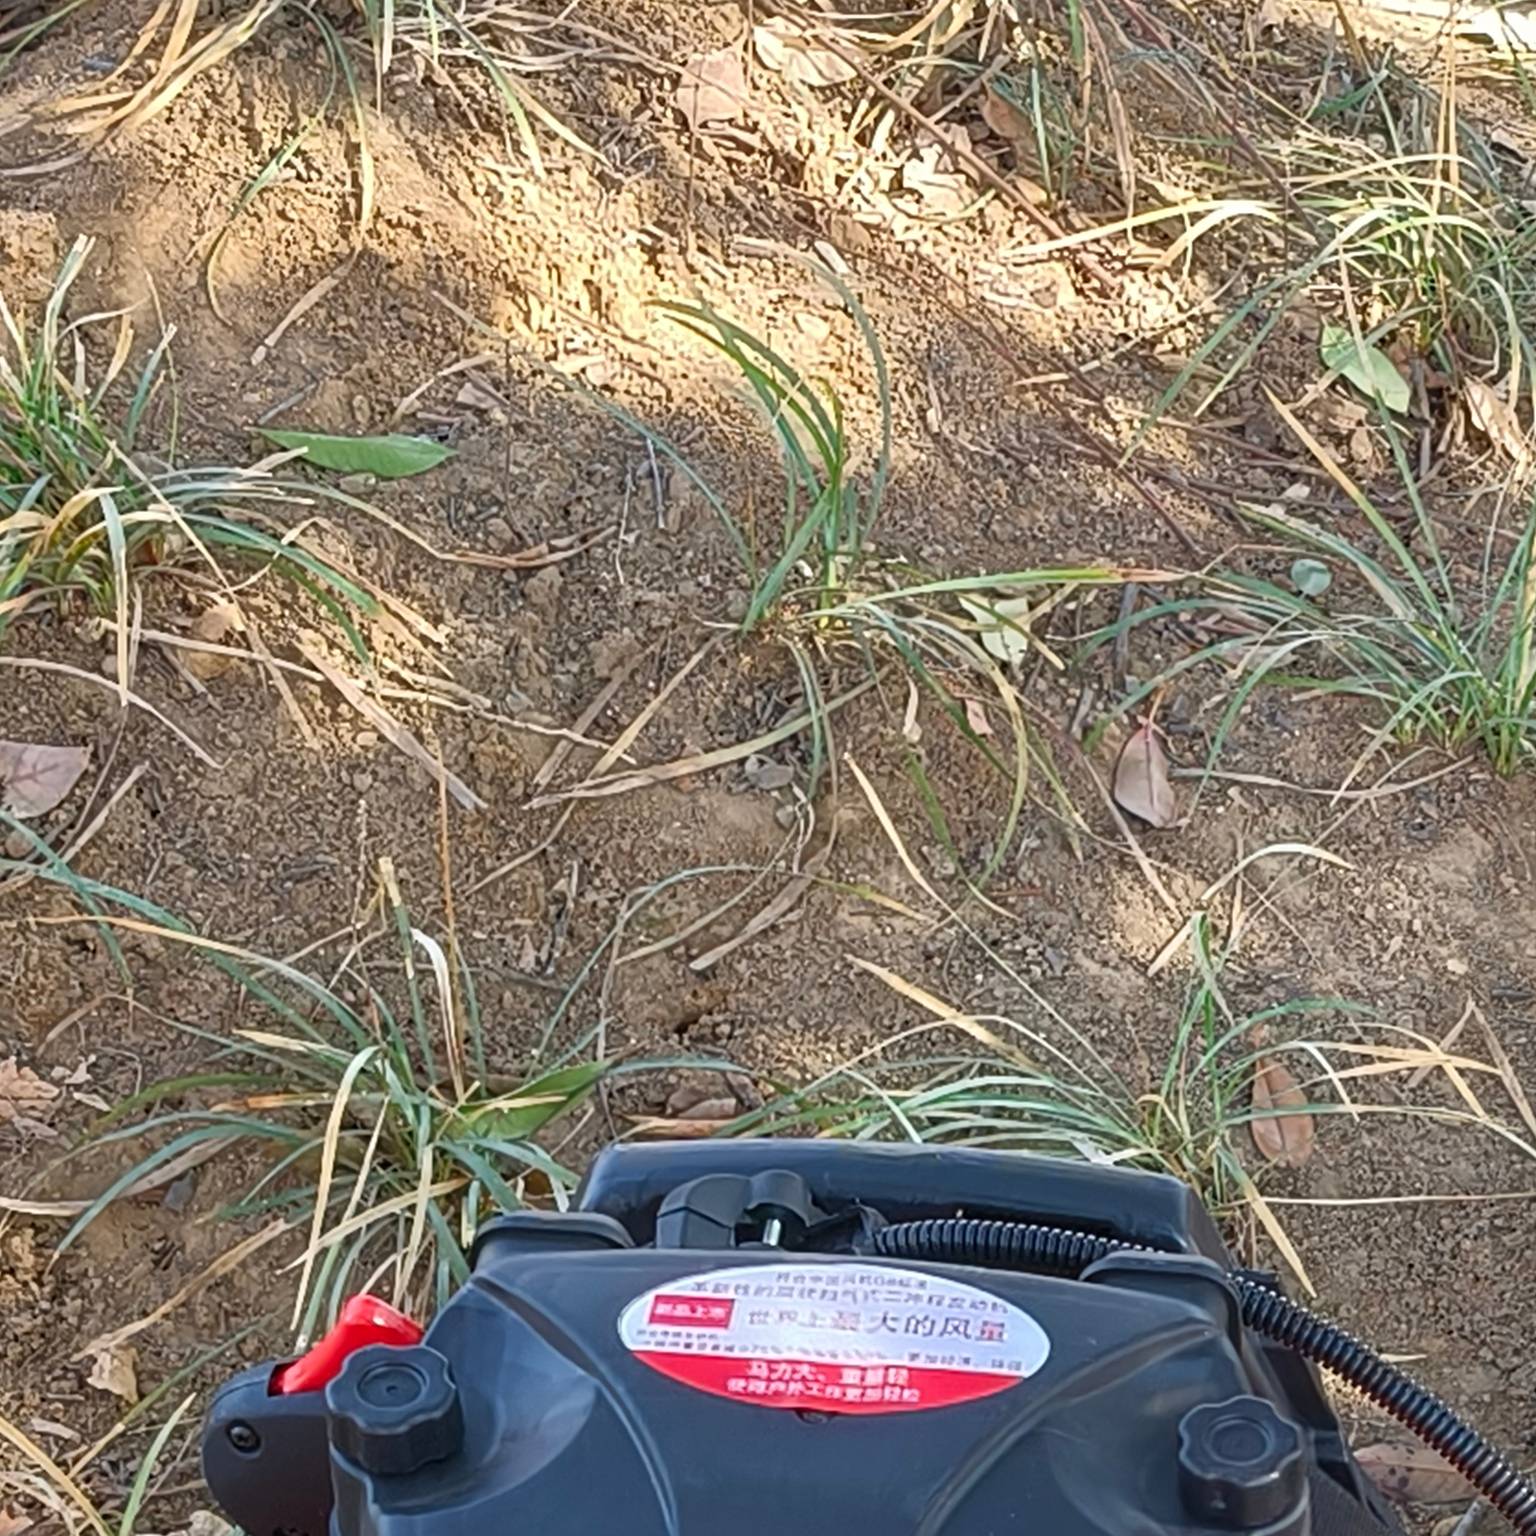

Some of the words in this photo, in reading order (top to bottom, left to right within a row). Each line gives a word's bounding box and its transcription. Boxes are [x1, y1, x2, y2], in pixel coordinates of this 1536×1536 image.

[747, 1309, 1006, 1343] 世界上最大的风量
